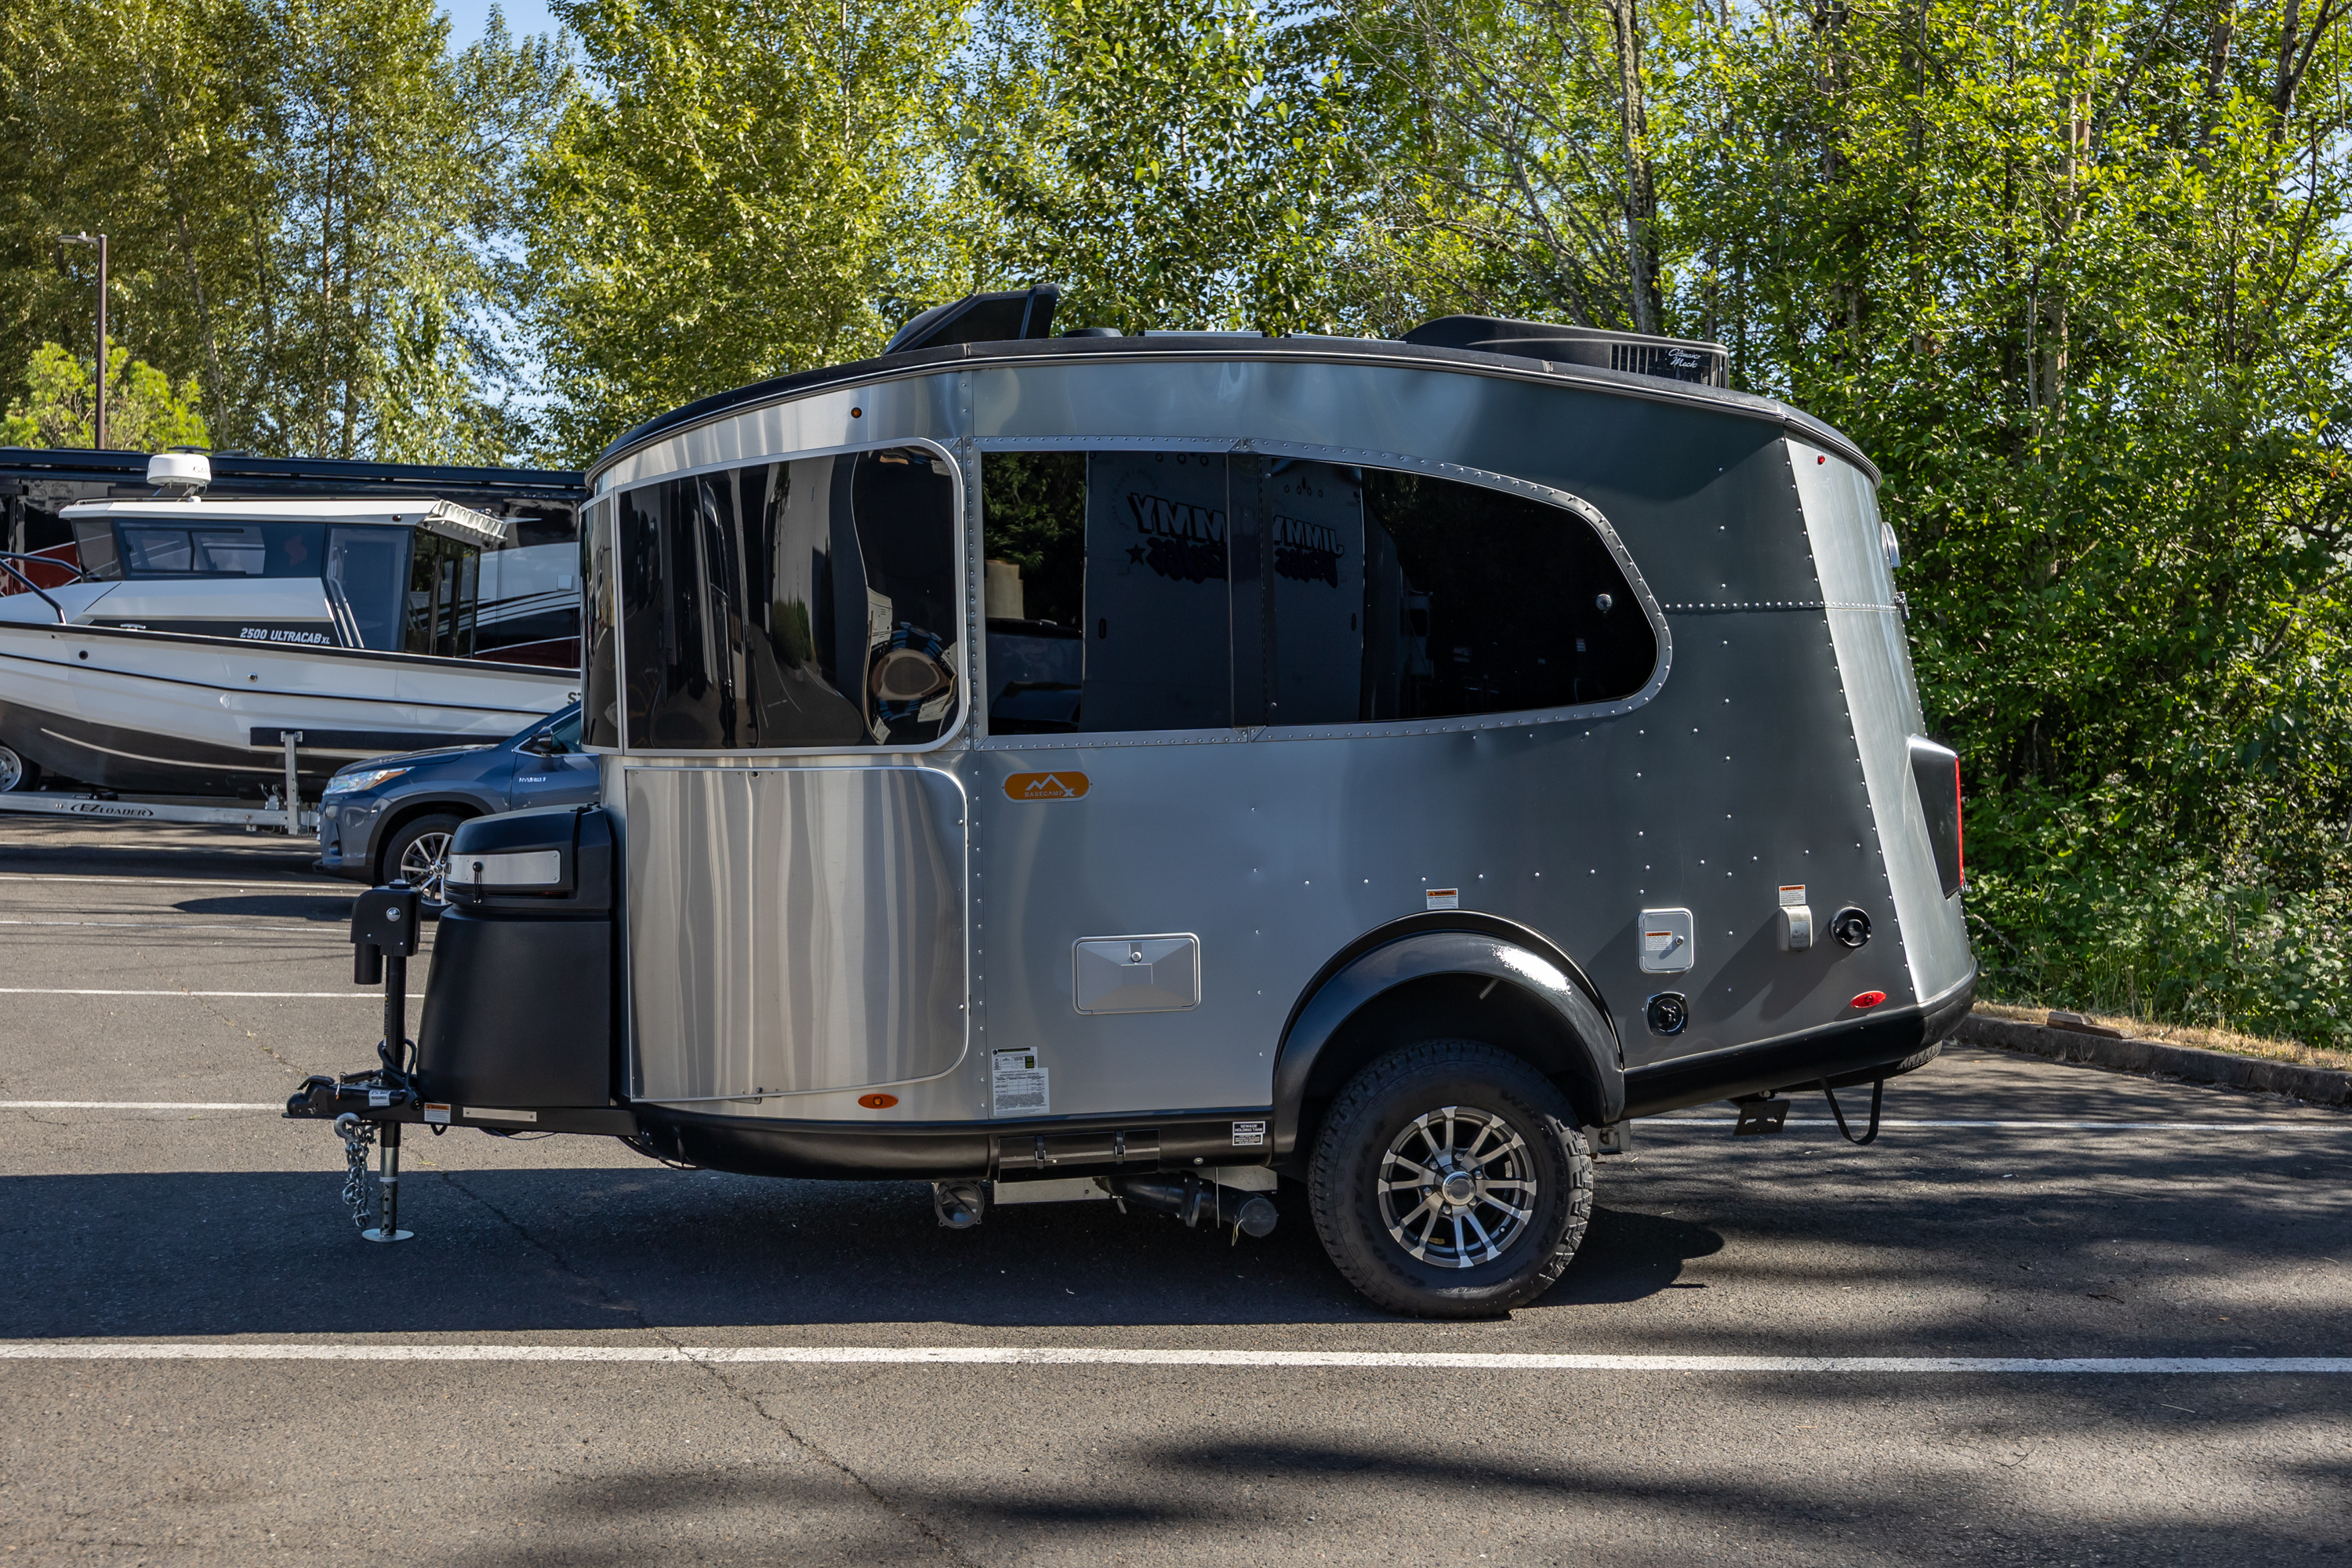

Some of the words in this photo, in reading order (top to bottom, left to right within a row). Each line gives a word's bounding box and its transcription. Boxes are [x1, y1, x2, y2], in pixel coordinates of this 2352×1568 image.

[1668, 348, 1700, 359] Coleman
[1671, 357, 1697, 368] Mach
[240, 628, 267, 639] 2500
